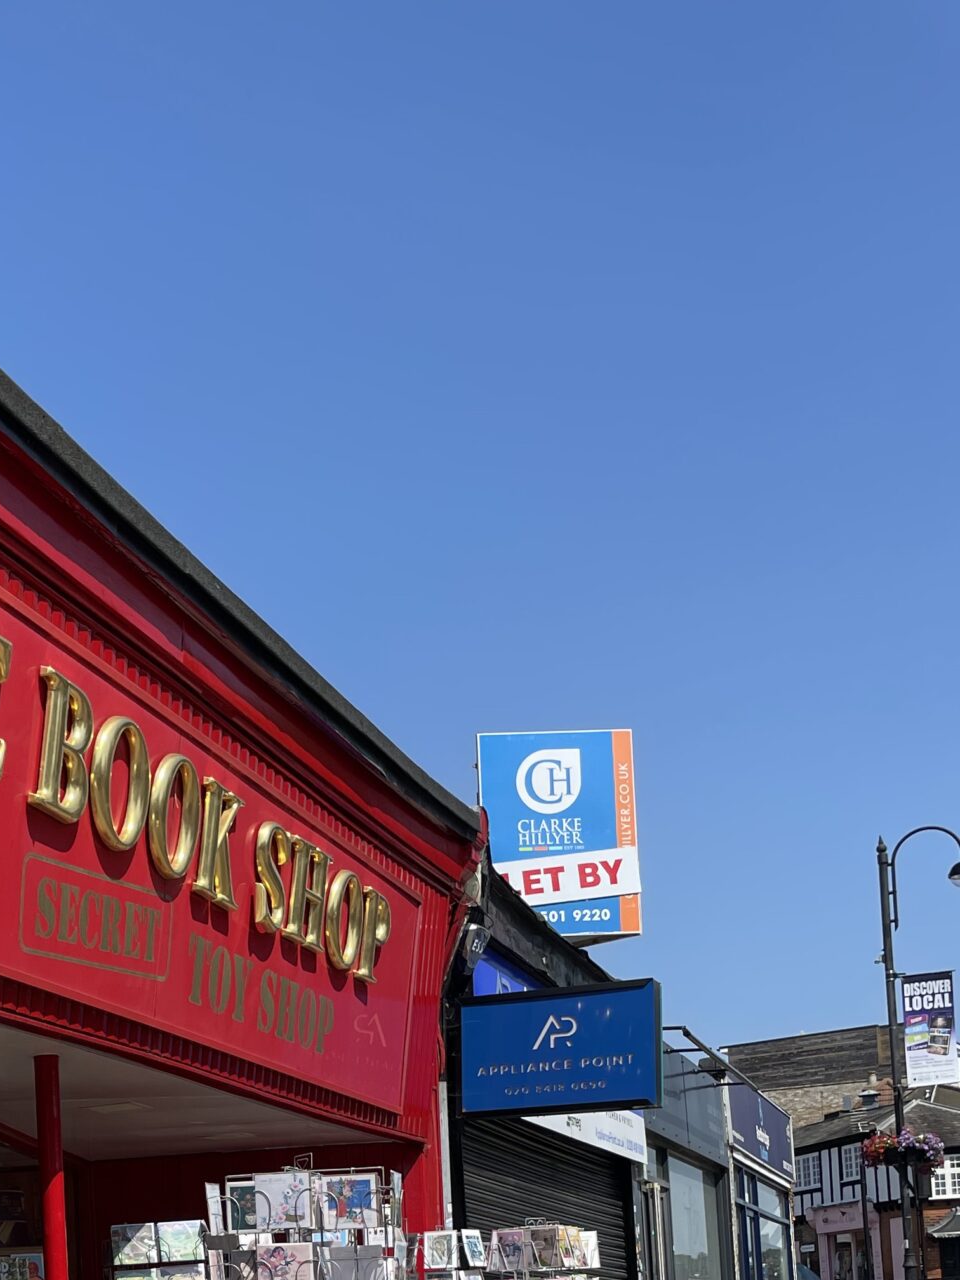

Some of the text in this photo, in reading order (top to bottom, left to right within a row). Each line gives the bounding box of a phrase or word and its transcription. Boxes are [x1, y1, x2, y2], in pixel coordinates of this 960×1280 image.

[27, 665, 246, 912] BOOK
[254, 820, 392, 984] SHOP
[517, 818, 583, 834] CLARKE
[518, 831, 585, 846] HILLYER
[577, 858, 624, 889] BY
[572, 909, 611, 921] 9220
[33, 876, 335, 1055] SECRET TOY SHOP
[903, 979, 952, 997] DISCOVER
[904, 993, 952, 1012] LOCAL
[477, 1053, 635, 1078] APPLIANCE POINT
